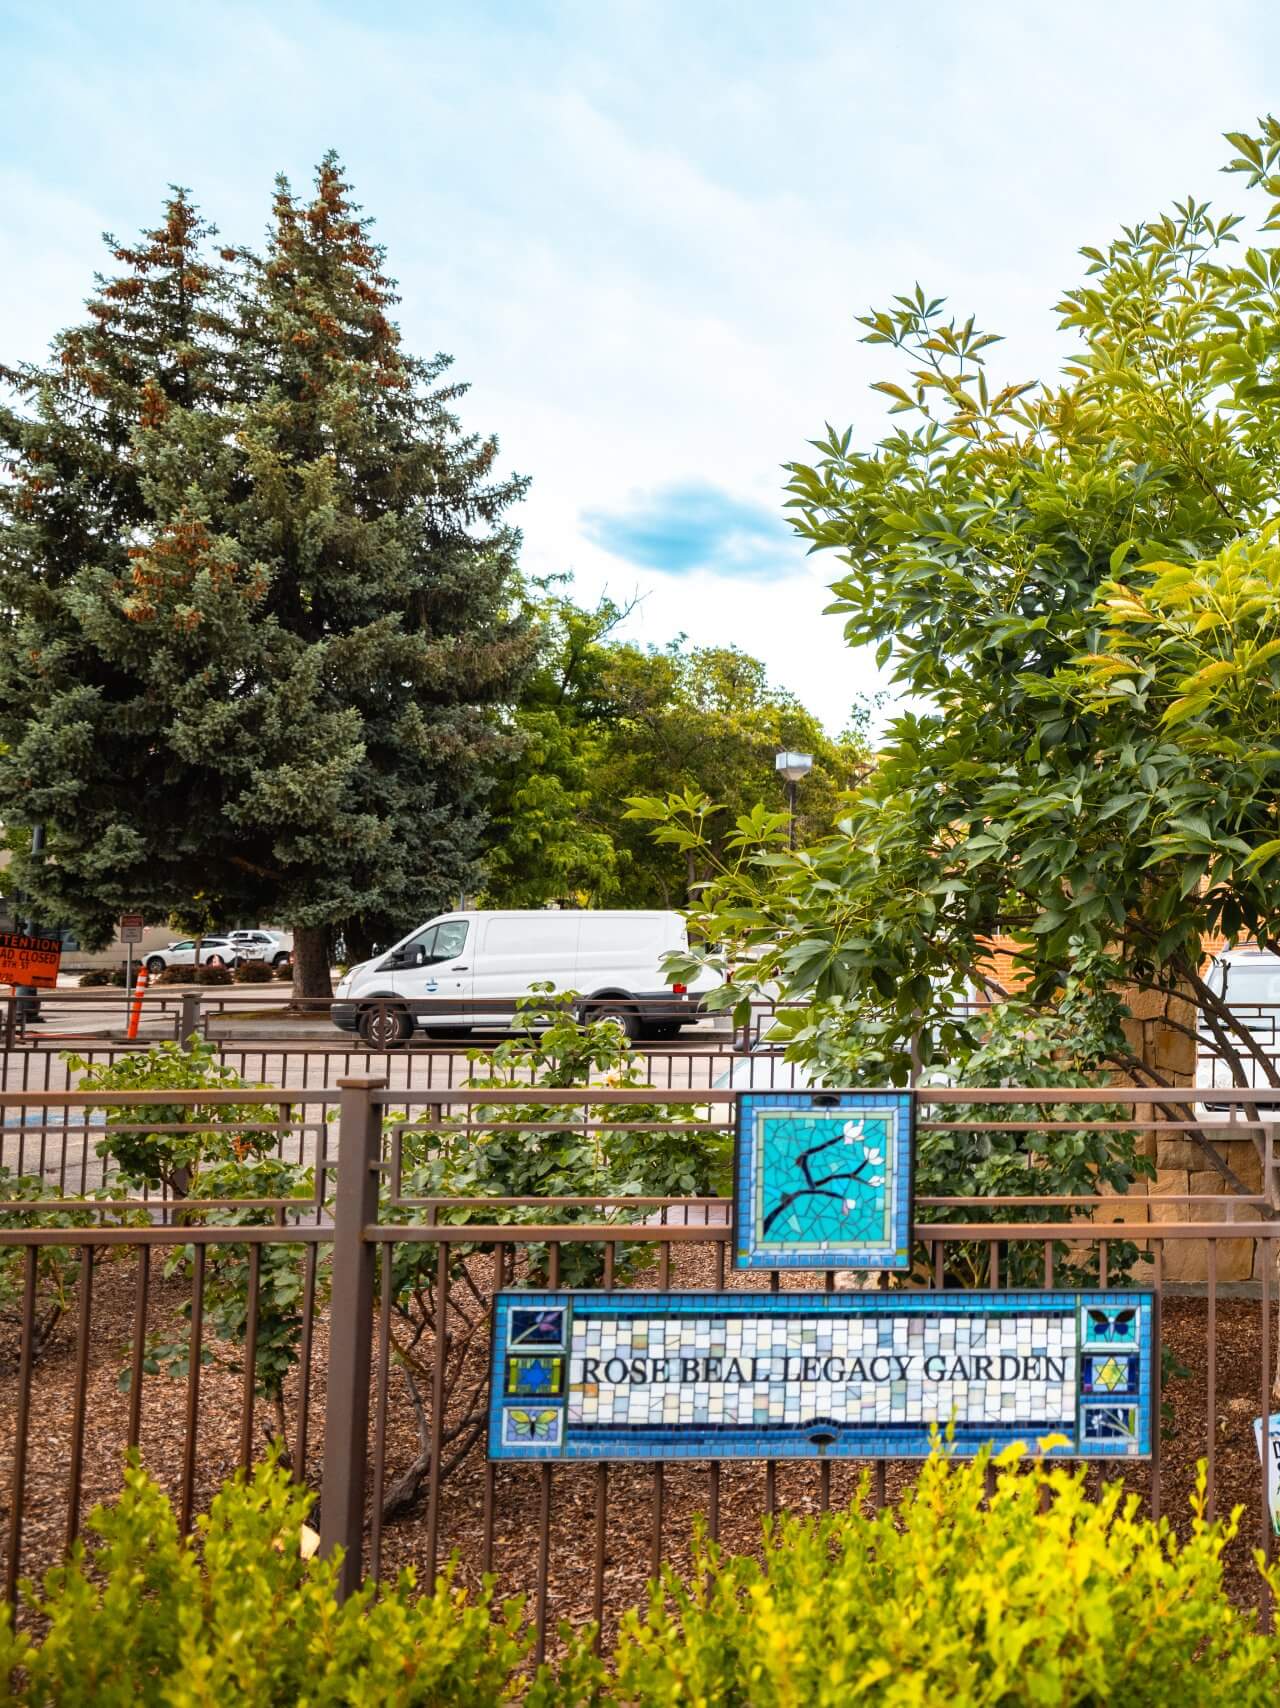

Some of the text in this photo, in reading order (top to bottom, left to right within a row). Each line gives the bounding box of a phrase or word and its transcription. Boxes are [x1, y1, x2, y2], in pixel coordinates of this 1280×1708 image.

[0, 935, 59, 951] TENTION
[19, 950, 57, 964] CLOSED
[582, 1354, 1068, 1385] ROSE BEAL LEGACY GARDEN
